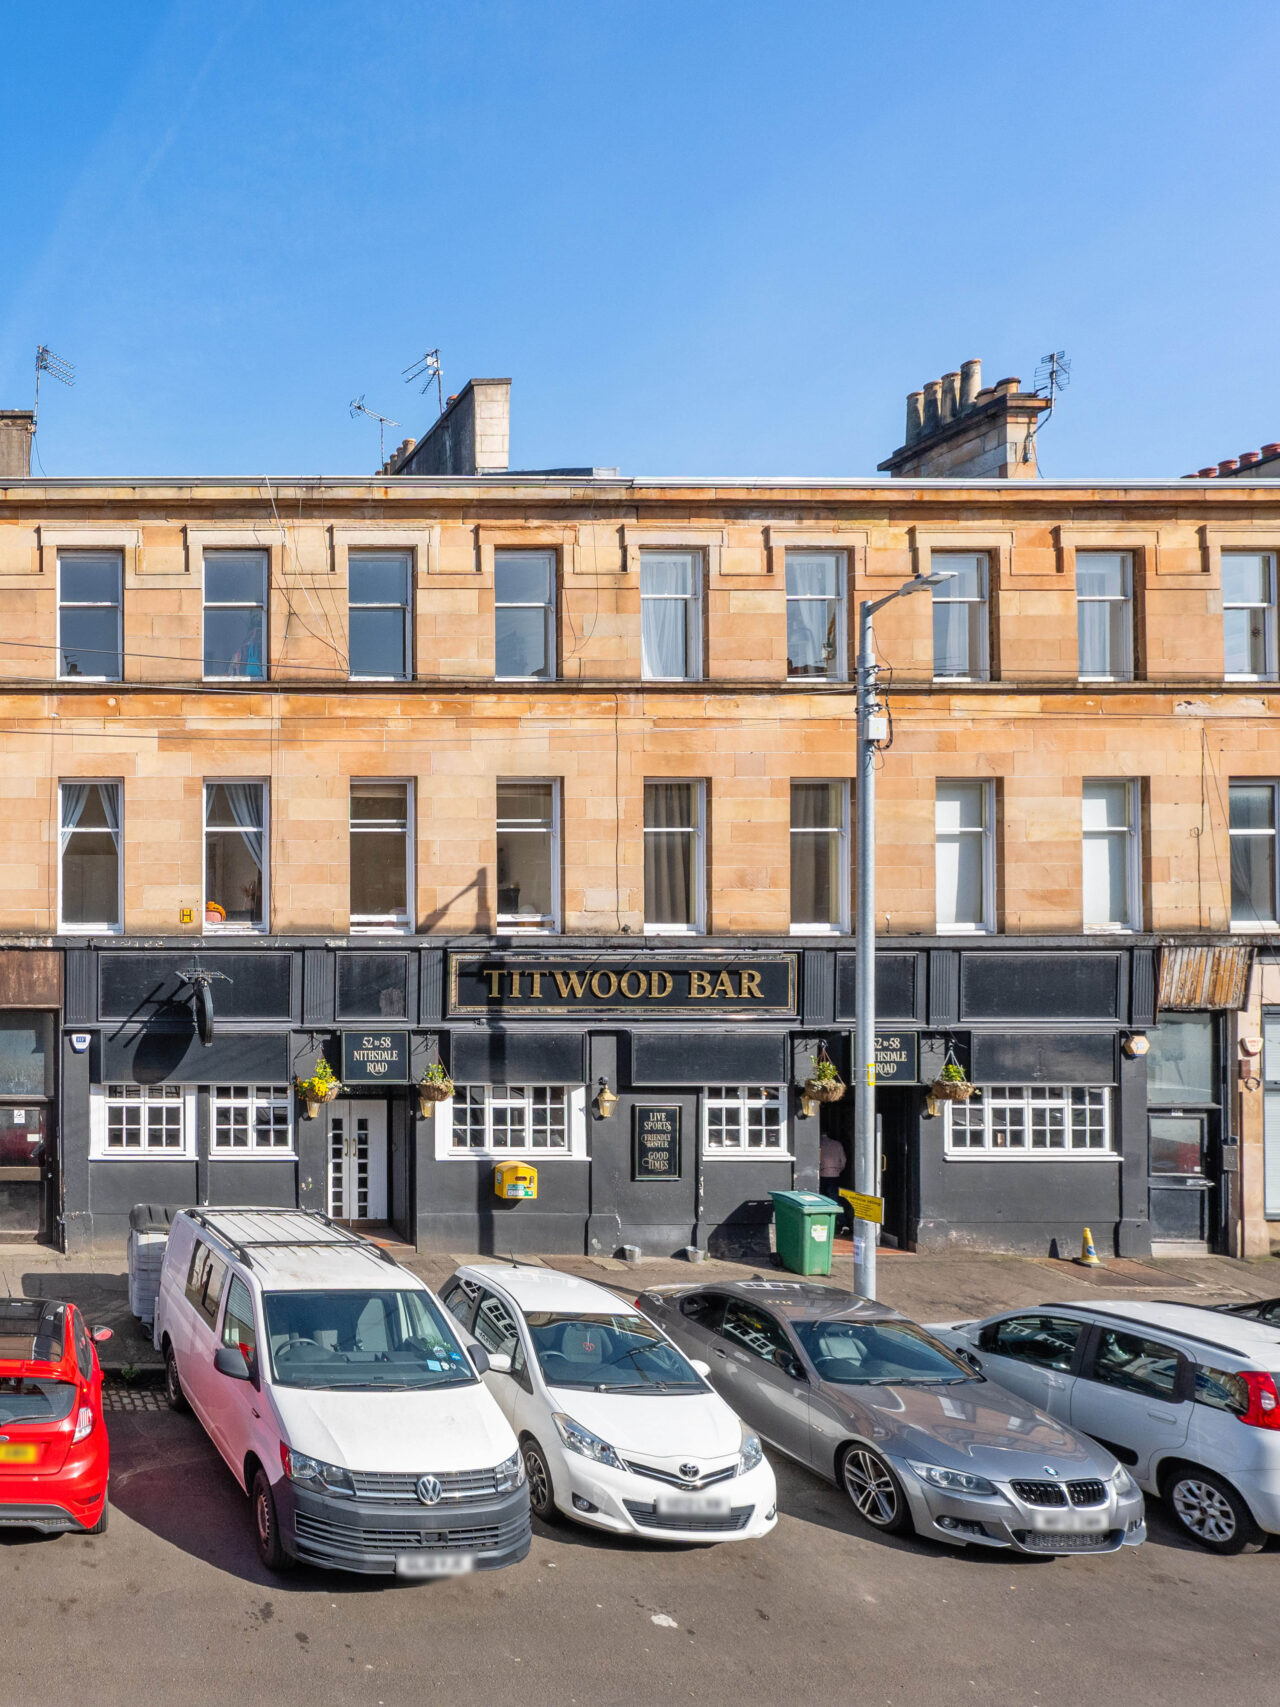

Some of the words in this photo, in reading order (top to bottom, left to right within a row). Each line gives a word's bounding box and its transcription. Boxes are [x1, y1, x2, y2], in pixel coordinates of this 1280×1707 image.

[483, 970, 673, 999] TITWOOD
[687, 970, 765, 999] BAR
[362, 1036, 373, 1048] 52
[380, 1036, 391, 1048] 58
[889, 1037, 900, 1049] 58
[353, 1050, 399, 1061] NITHSDALE
[366, 1062, 388, 1077] ROAD
[875, 1062, 897, 1077] ROAD
[649, 1112, 667, 1121] LIVE
[644, 1121, 671, 1132] SPORTS
[648, 1151, 669, 1160] GOOD
[642, 1158, 669, 1171] TIMES
